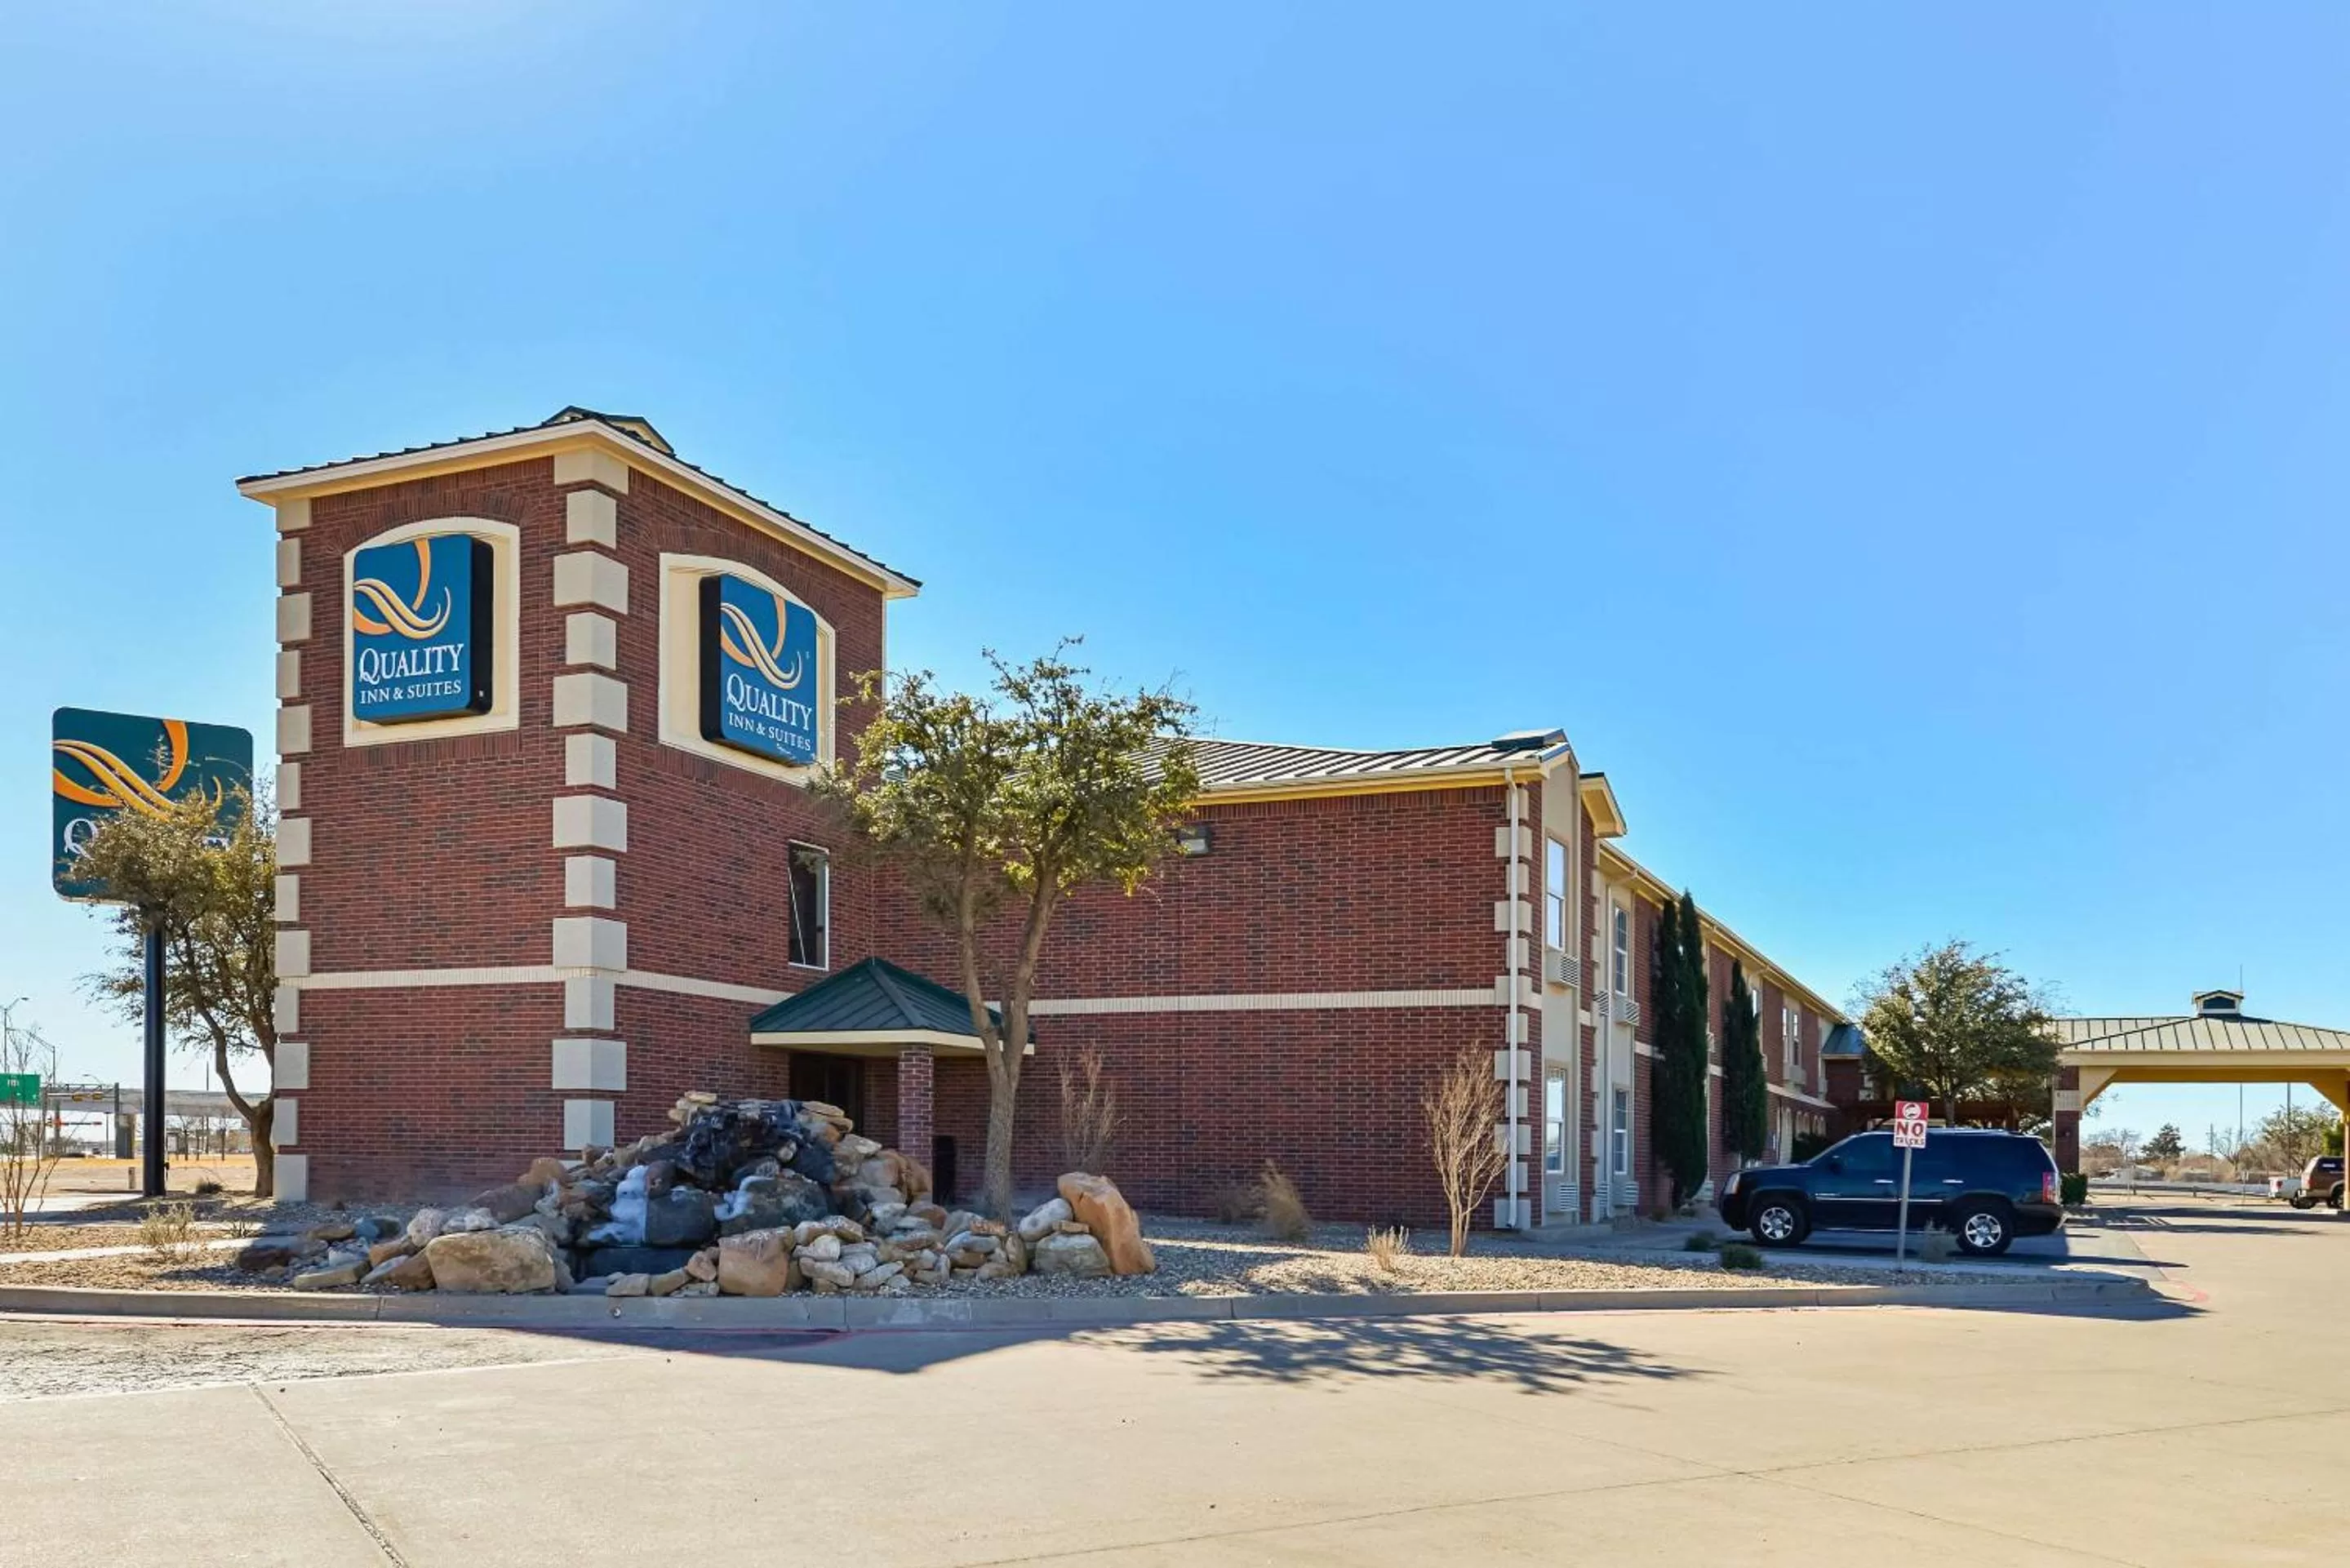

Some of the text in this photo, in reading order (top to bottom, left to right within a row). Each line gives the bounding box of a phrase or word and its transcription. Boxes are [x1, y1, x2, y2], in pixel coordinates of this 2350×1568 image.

[359, 643, 464, 685] QUALITY
[360, 680, 462, 704] INN & SUITES
[726, 673, 813, 731] QUALITY
[728, 712, 811, 751] INN & SUITES
[1896, 1121, 1924, 1137] NO
